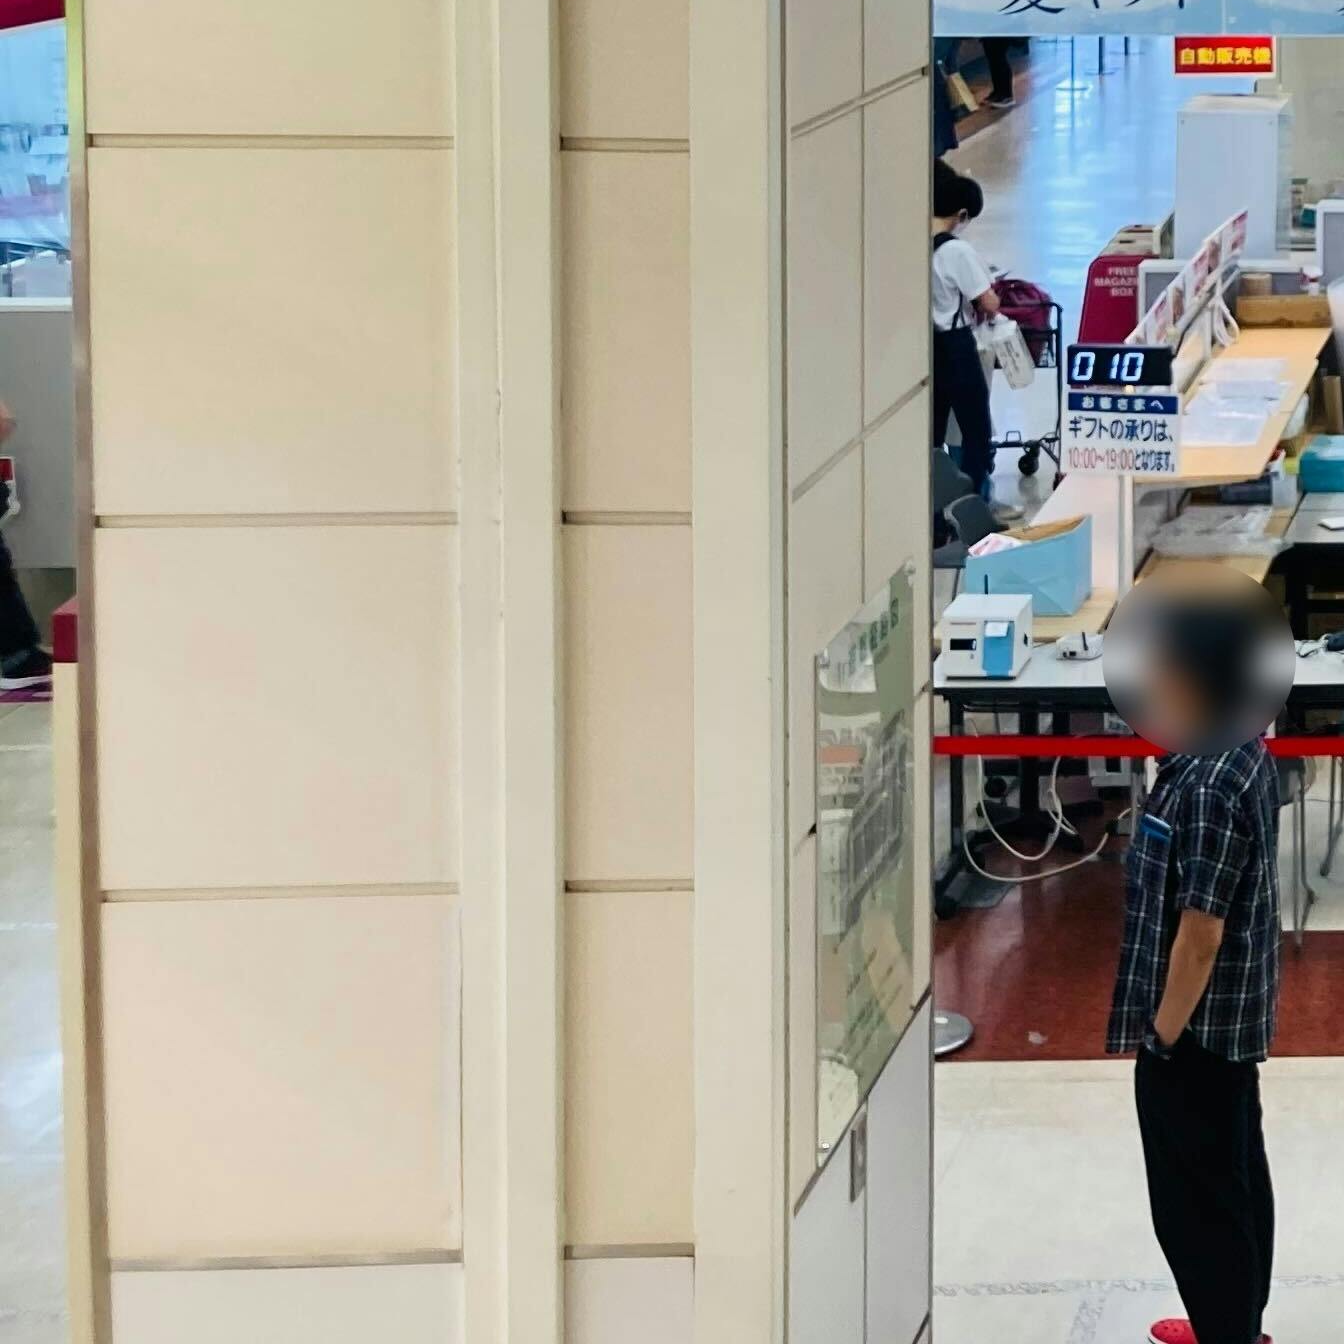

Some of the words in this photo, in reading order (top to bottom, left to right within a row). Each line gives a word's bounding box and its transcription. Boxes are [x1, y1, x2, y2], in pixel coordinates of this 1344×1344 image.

[1180, 47, 1273, 66] 自動販売機
[1110, 287, 1134, 297] BOX
[1082, 396, 1164, 411] お客さまへ
[1068, 416, 1174, 444] ギフトの承りは、
